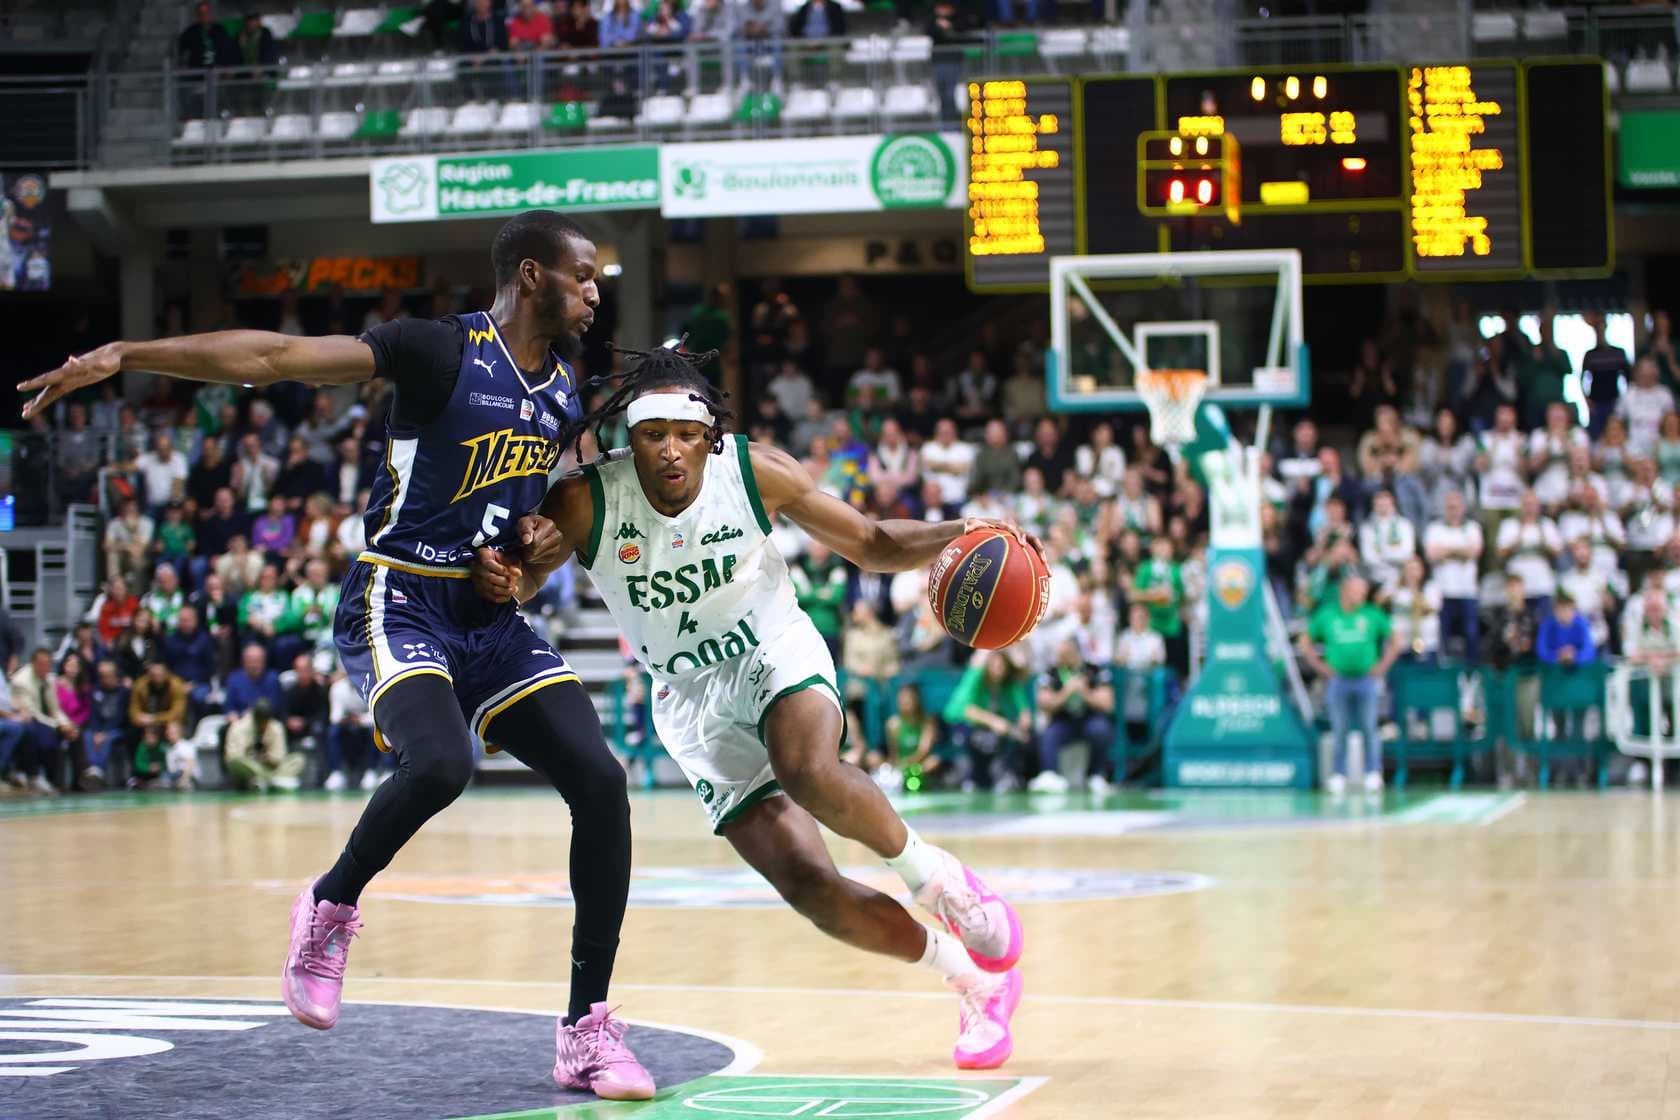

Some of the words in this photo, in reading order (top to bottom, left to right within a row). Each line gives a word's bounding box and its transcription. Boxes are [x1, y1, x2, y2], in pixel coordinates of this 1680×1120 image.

[440, 162, 512, 184] Région
[440, 178, 658, 210] Hauts-de-France
[472, 503, 510, 547] 5
[677, 611, 698, 638] 4
